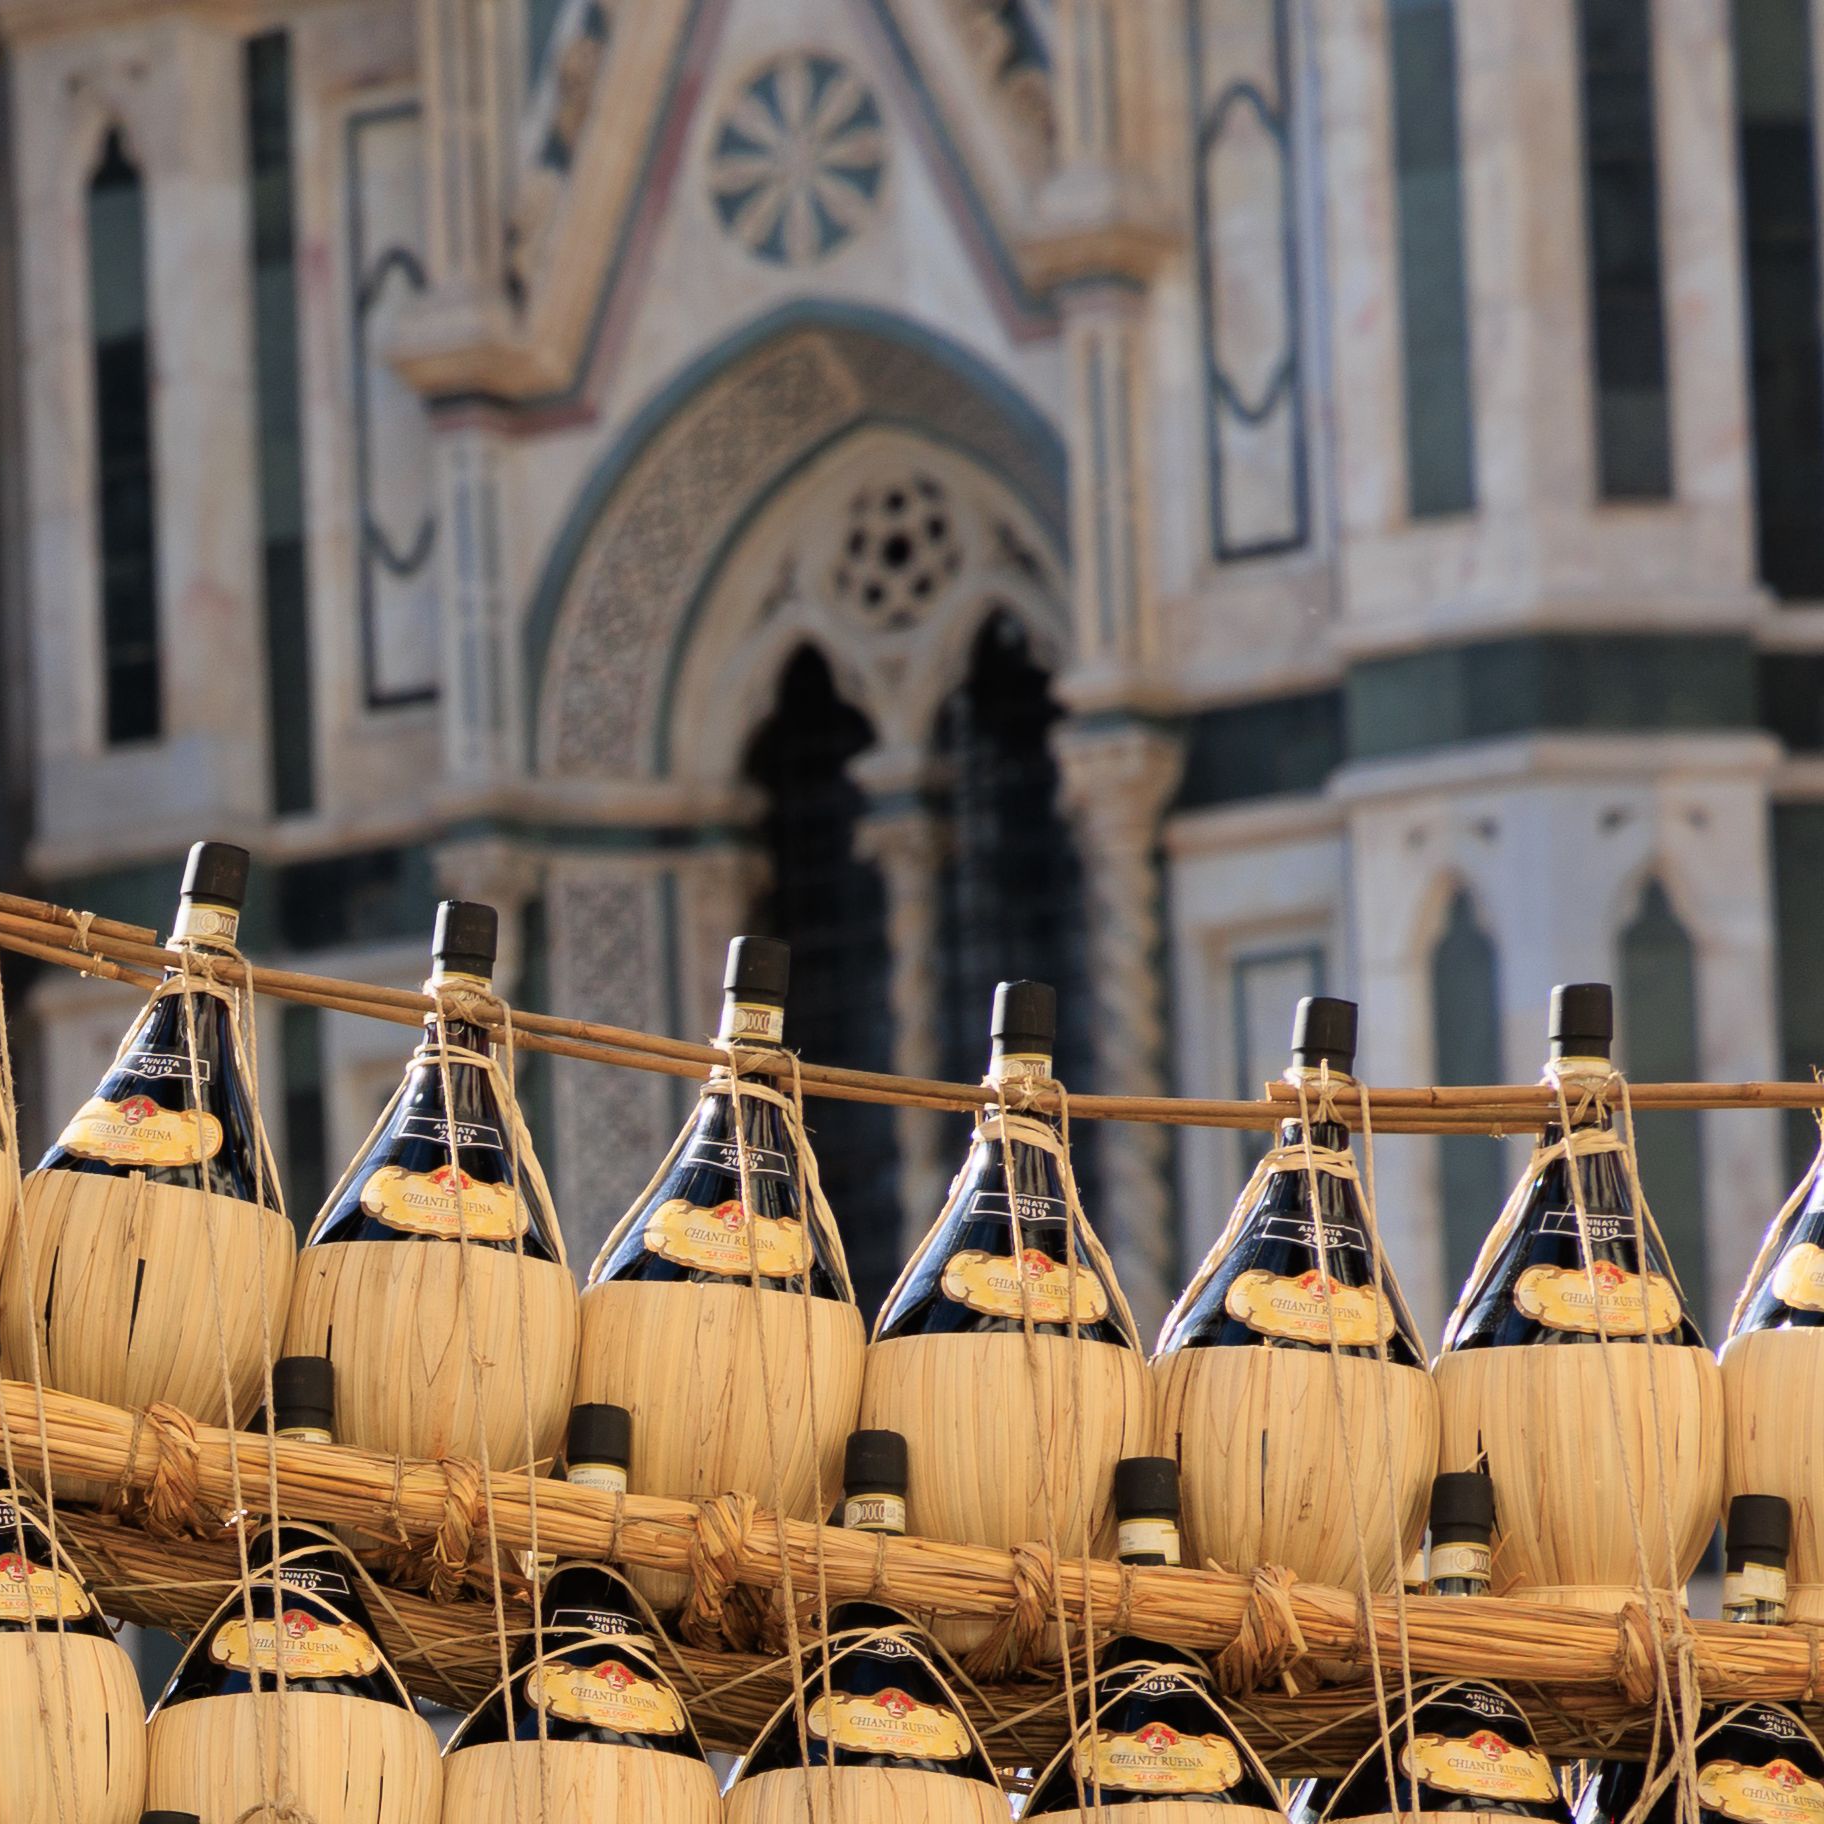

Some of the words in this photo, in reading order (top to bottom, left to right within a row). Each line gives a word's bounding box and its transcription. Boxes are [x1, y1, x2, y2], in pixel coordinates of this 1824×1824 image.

[138, 1056, 181, 1069] ANNATA
[138, 1063, 173, 1075] 2019
[131, 1127, 172, 1141] RUFINA
[433, 1123, 478, 1136] ANATA
[723, 1156, 758, 1170] 209
[402, 1191, 451, 1209] CHIANTI
[1016, 1204, 1047, 1219] 2019
[1586, 1218, 1620, 1227] NNATA
[683, 1226, 733, 1244] CHIANTI
[734, 1236, 775, 1251] RUINA
[1298, 1224, 1343, 1238] ANATA
[1586, 1225, 1619, 1237] 2019
[1039, 1283, 1072, 1298] RUFIN
[1270, 1297, 1319, 1314] CHIANTI
[586, 1614, 629, 1628] ANNATA
[299, 1642, 340, 1653] RUFINA
[1140, 1682, 1176, 1692] 2019
[571, 1685, 620, 1703] CHIANTI
[622, 1695, 658, 1711] RUFINA
[1465, 1692, 1506, 1709] ANNATA
[1472, 1701, 1505, 1716] 2019
[851, 1714, 898, 1730] CHIANTI
[901, 1722, 940, 1736] RUFINA
[1764, 1721, 1796, 1737] 2019
[1109, 1753, 1159, 1766] CHIANTI
[1161, 1757, 1204, 1768] RUFINA
[1448, 1757, 1497, 1773] CHIANTI
